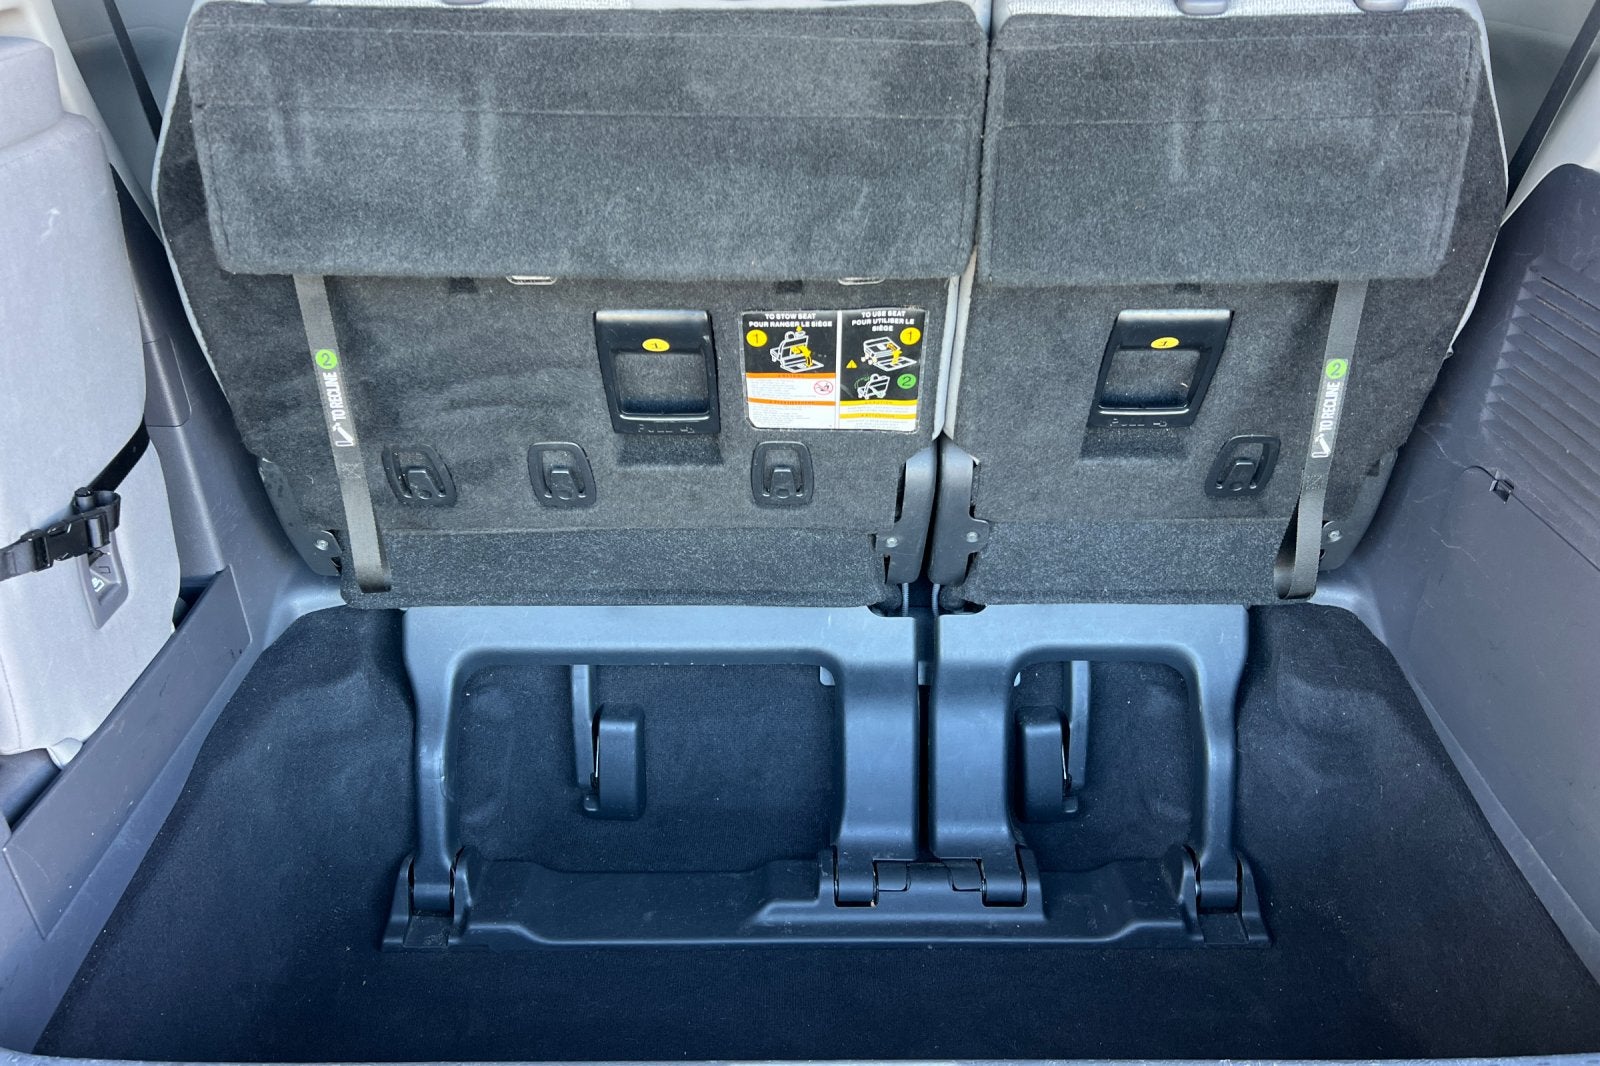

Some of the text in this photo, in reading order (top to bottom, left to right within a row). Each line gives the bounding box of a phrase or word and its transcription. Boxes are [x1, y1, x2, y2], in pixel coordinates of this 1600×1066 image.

[321, 352, 332, 366] 2
[1330, 362, 1342, 376] 2
[323, 372, 346, 422] TO RECLINE
[1319, 382, 1340, 432] TO RECLINE
